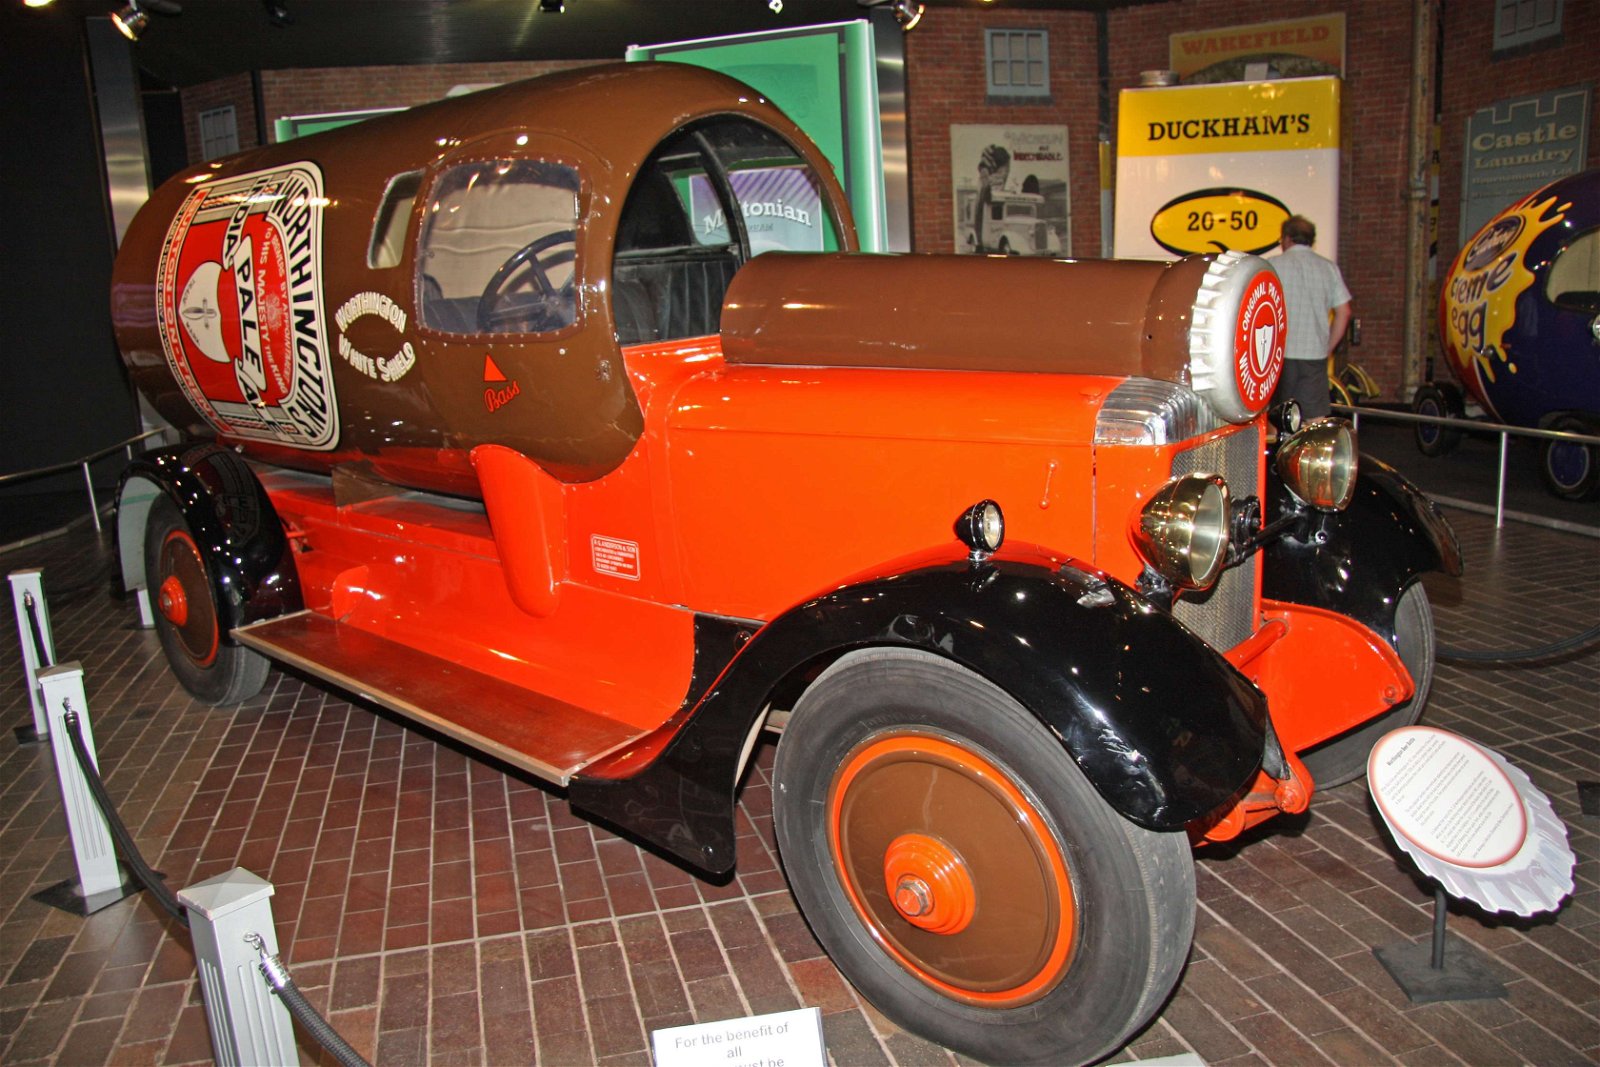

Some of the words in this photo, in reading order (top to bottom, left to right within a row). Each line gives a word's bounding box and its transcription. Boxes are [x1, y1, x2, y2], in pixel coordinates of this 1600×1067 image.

[1182, 25, 1330, 55] WAKEFIELD
[1147, 113, 1311, 141] DUCKHAM'S
[1471, 122, 1578, 151] Castle
[1474, 147, 1575, 170] Laundry
[703, 199, 813, 236] Mtonian
[1187, 211, 1258, 232] 20-50
[260, 241, 271, 265] HIS
[280, 281, 288, 299] BY
[237, 256, 262, 375] PALE
[257, 269, 270, 342] MAJESTY
[271, 176, 327, 438] WORTHINGTON'S
[335, 291, 407, 334] WORTHINGTON
[1242, 281, 1267, 332] ORIGINAL
[1268, 281, 1281, 307] PALE
[1277, 304, 1285, 333] ALE
[1450, 301, 1488, 354] egg
[265, 345, 274, 363] THE
[338, 333, 378, 380] WHITE
[376, 341, 416, 382] SHIELD
[271, 364, 288, 394] KING
[1239, 351, 1257, 401] WHITE
[1259, 346, 1283, 401] SHIELD
[484, 380, 520, 412] Bass
[675, 1036, 697, 1049] For
[702, 1033, 722, 1046] the
[726, 1024, 773, 1042] benefit
[776, 1021, 789, 1034] of
[727, 1046, 742, 1059] all
